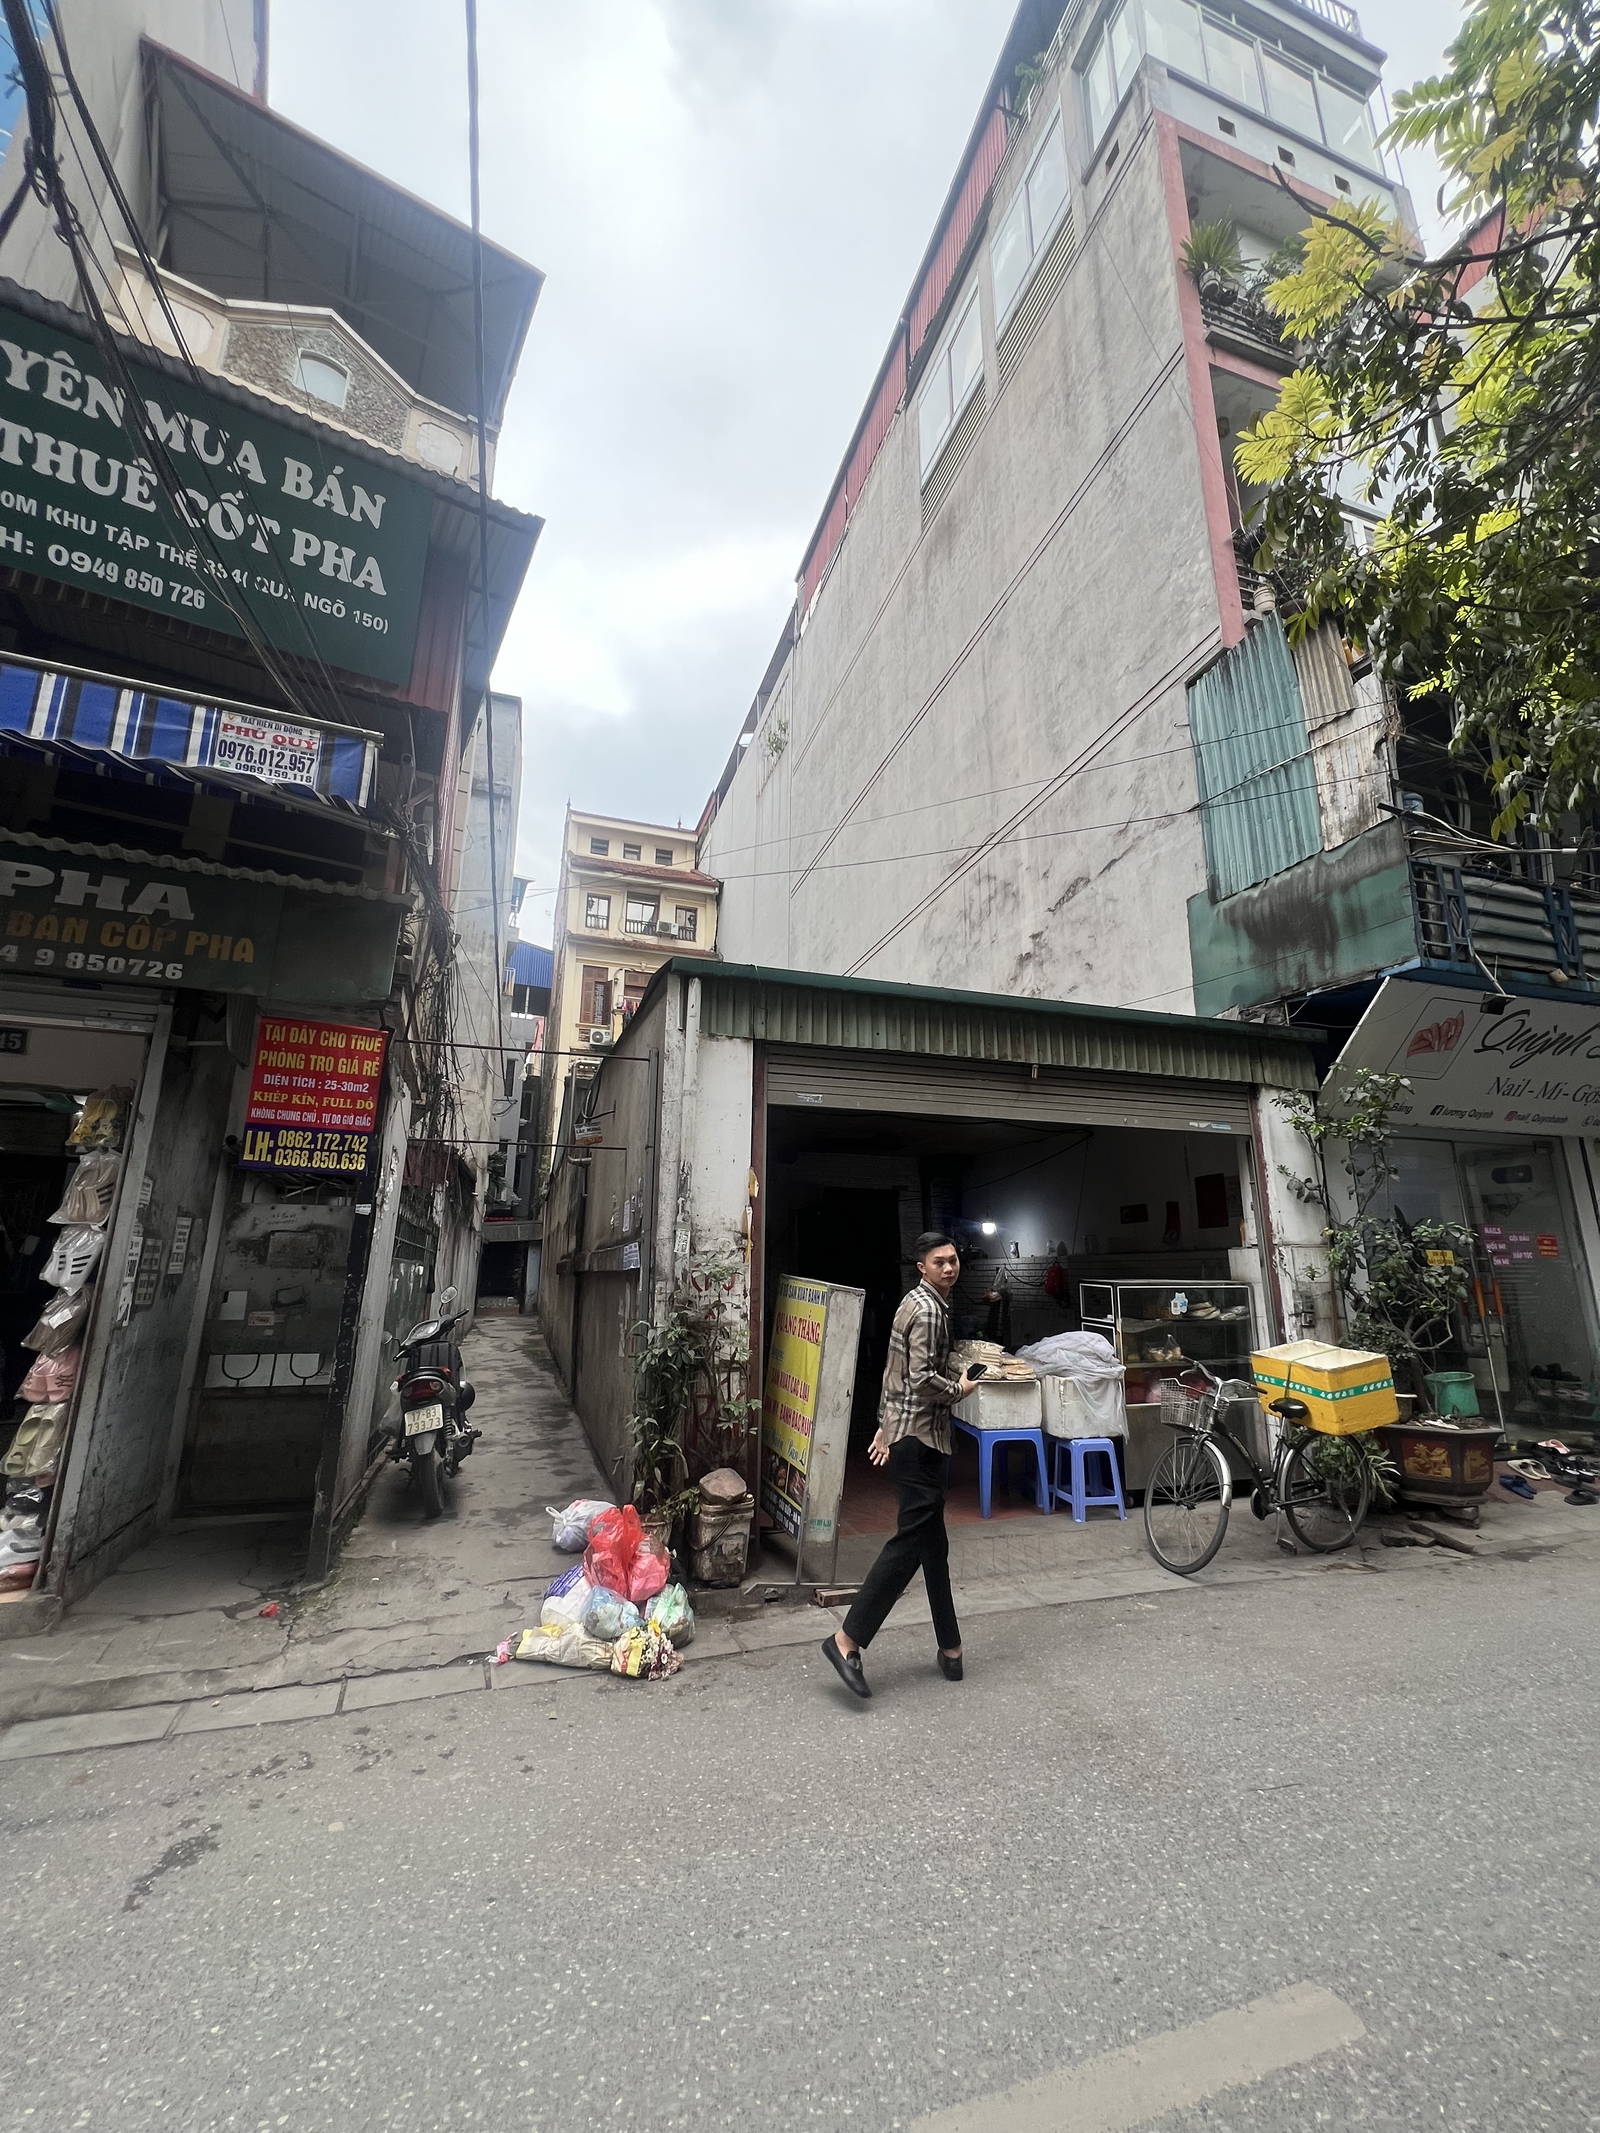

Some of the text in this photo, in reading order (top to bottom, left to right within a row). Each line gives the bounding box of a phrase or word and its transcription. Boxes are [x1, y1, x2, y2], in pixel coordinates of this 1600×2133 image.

[281, 457, 387, 530] BÁN
[46, 504, 97, 536] KHU
[104, 524, 150, 551] TẬP
[156, 541, 198, 570] THỂ
[303, 592, 346, 619] NGÕ
[353, 610, 389, 635] 150)
[48, 544, 119, 584] 0949
[124, 568, 163, 598] 850
[169, 581, 206, 610] 726
[289, 528, 388, 597] PHA
[217, 739, 316, 775] 0976.012.957
[235, 762, 312, 784] 0969.159.118
[0, 860, 194, 921] PHA
[184, 931, 256, 964] PHA
[34, 948, 55, 966] 9
[65, 951, 184, 980] 850726
[264, 1023, 383, 1053] TẠI ĐÂY CHO THUÊ
[258, 1047, 380, 1077] PHÒNG TRỌ GIÁ RẺ
[263, 1072, 289, 1088] DIỆN
[292, 1074, 316, 1089] TÍCH
[324, 1079, 370, 1093] 25-30m2
[253, 1090, 289, 1104] KHÉP
[321, 1096, 353, 1109] FULL
[276, 1109, 301, 1122] CHUNG
[242, 1129, 369, 1163] LH: 0862.172.742
[274, 1148, 367, 1171] 0368.850.636
